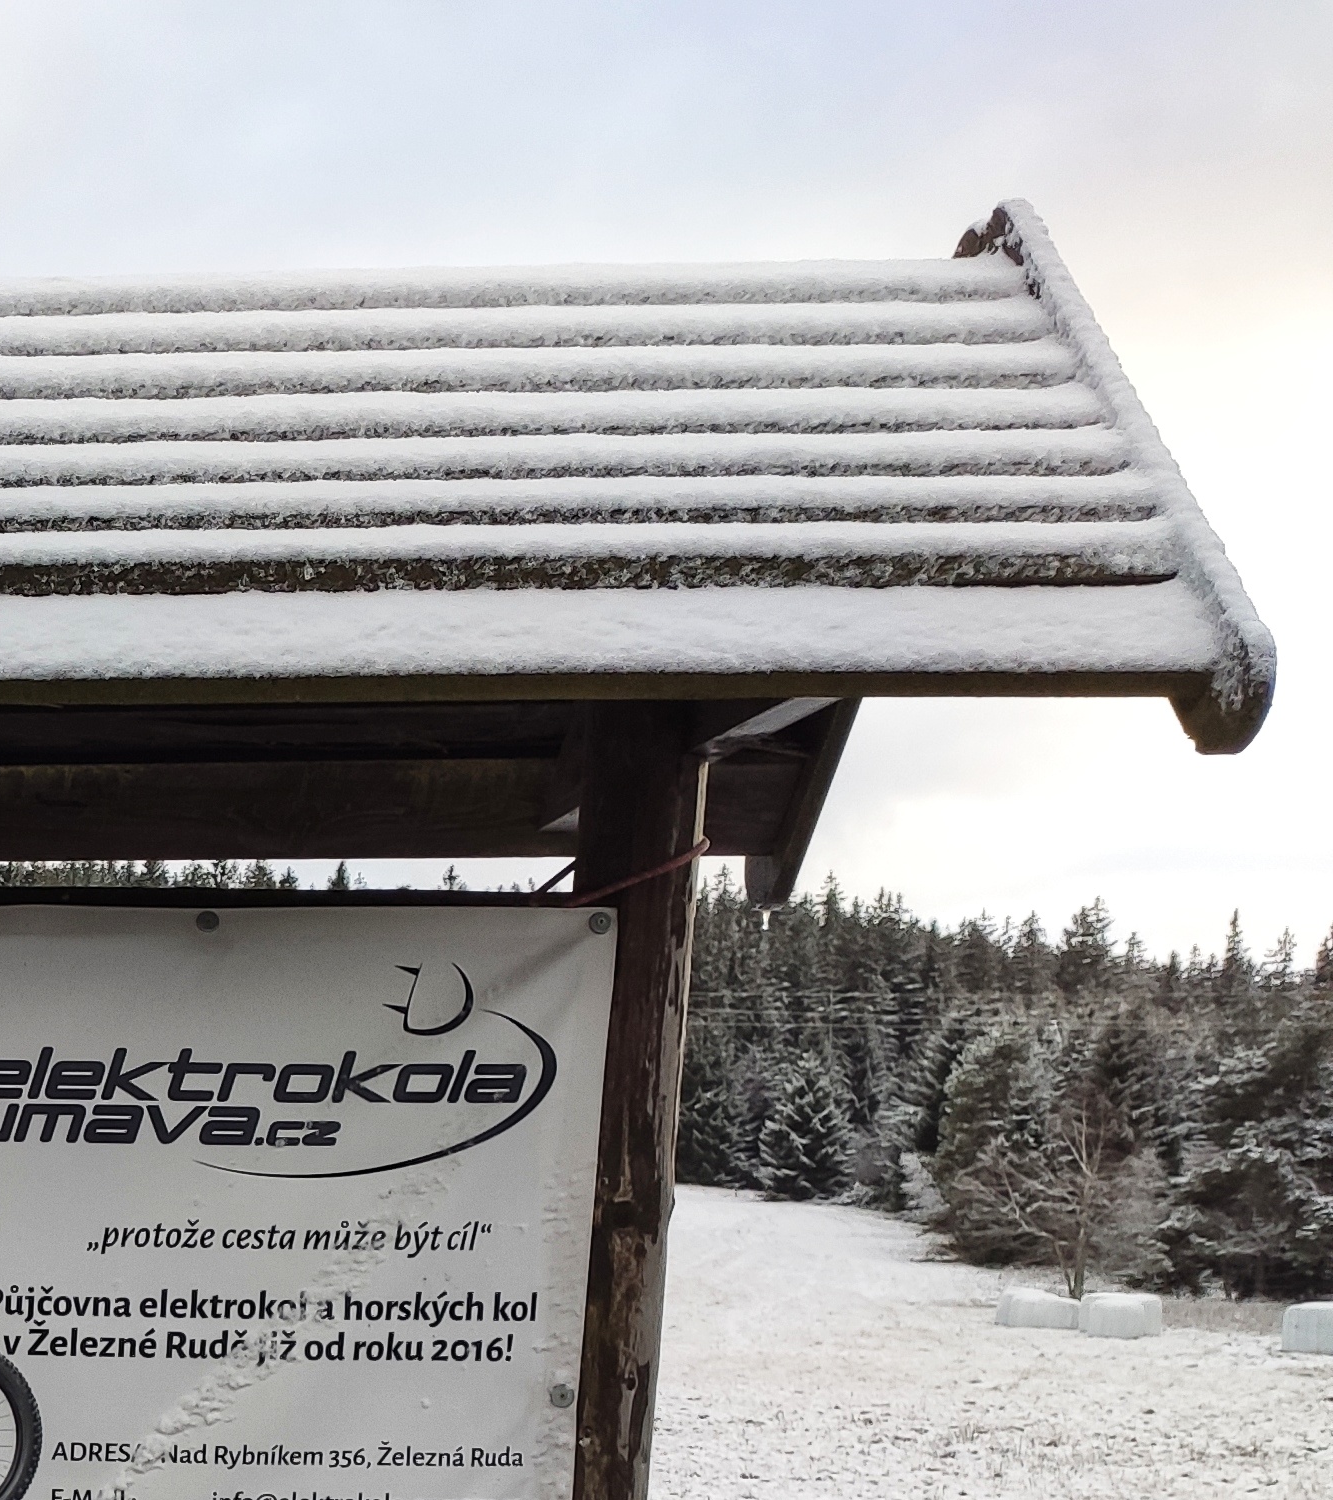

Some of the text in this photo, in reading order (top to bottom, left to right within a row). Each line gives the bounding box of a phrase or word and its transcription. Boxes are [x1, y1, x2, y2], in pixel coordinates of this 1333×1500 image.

[221, 1224, 296, 1250] cesta
[302, 1220, 387, 1251] může
[394, 1221, 444, 1259] být
[314, 1300, 335, 1321] a
[343, 1291, 484, 1328] horských
[492, 1291, 538, 1322] kol
[3, 1335, 22, 1356] v
[27, 1319, 157, 1359] Železné
[304, 1331, 346, 1361] od
[352, 1331, 424, 1362] roku
[430, 1333, 514, 1362] 2016!
[214, 1444, 324, 1470] Rybníkem
[328, 1447, 372, 1469] 356,
[376, 1440, 465, 1467] Železná
[470, 1445, 524, 1468] Ruda
